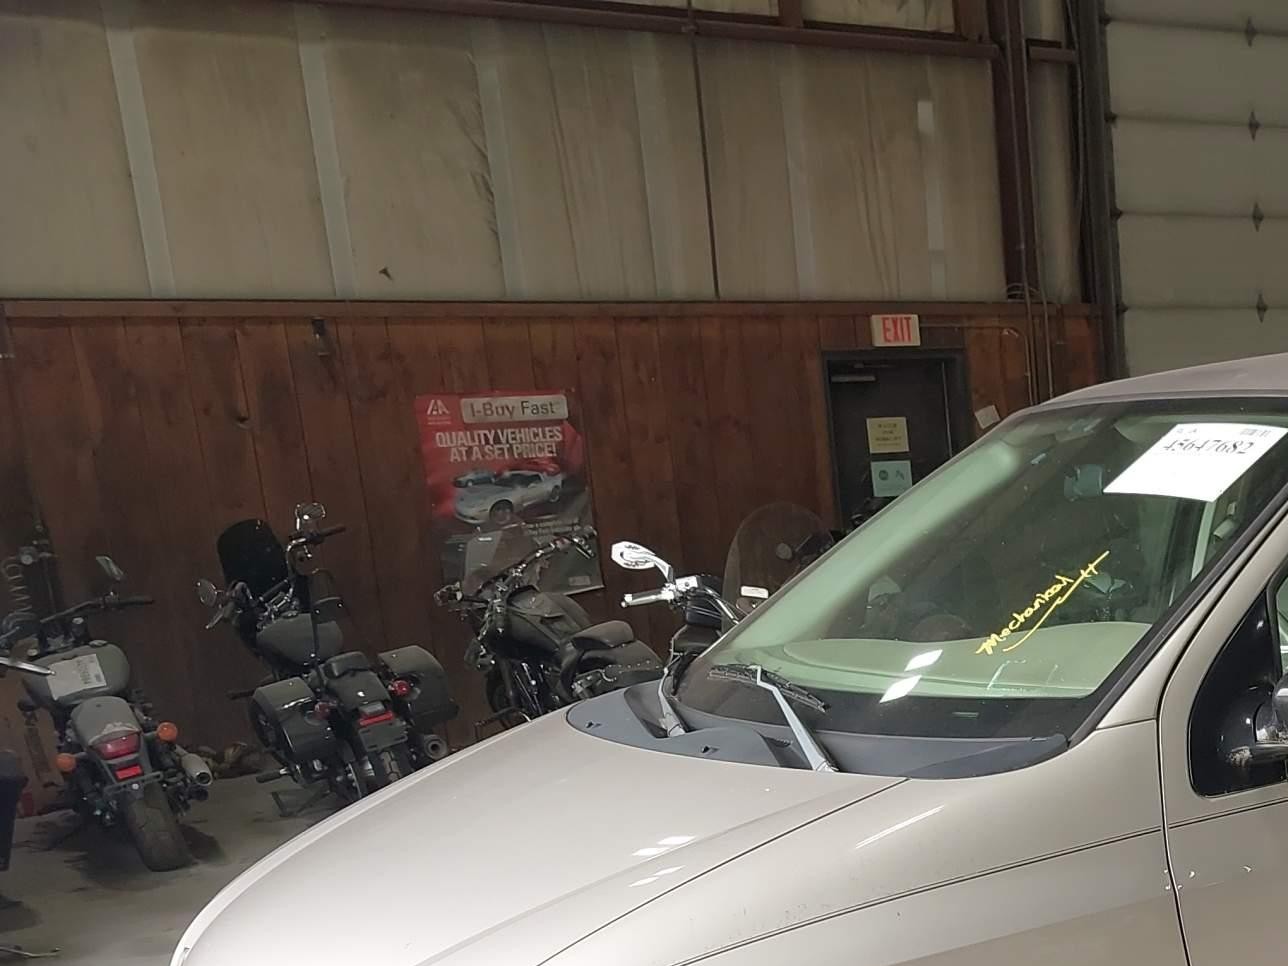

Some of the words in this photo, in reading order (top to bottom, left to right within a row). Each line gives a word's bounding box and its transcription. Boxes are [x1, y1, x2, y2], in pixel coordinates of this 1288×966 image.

[881, 316, 913, 343] EXIT
[470, 402, 515, 419] I-Buy
[520, 400, 556, 415] Fast
[435, 428, 496, 448] QUALITY
[496, 426, 563, 443] VEHICLES
[1163, 439, 1256, 455] 45647682
[450, 446, 468, 463] AT
[471, 445, 483, 461] A
[484, 444, 510, 460] SET
[513, 441, 557, 458] PRICE!
